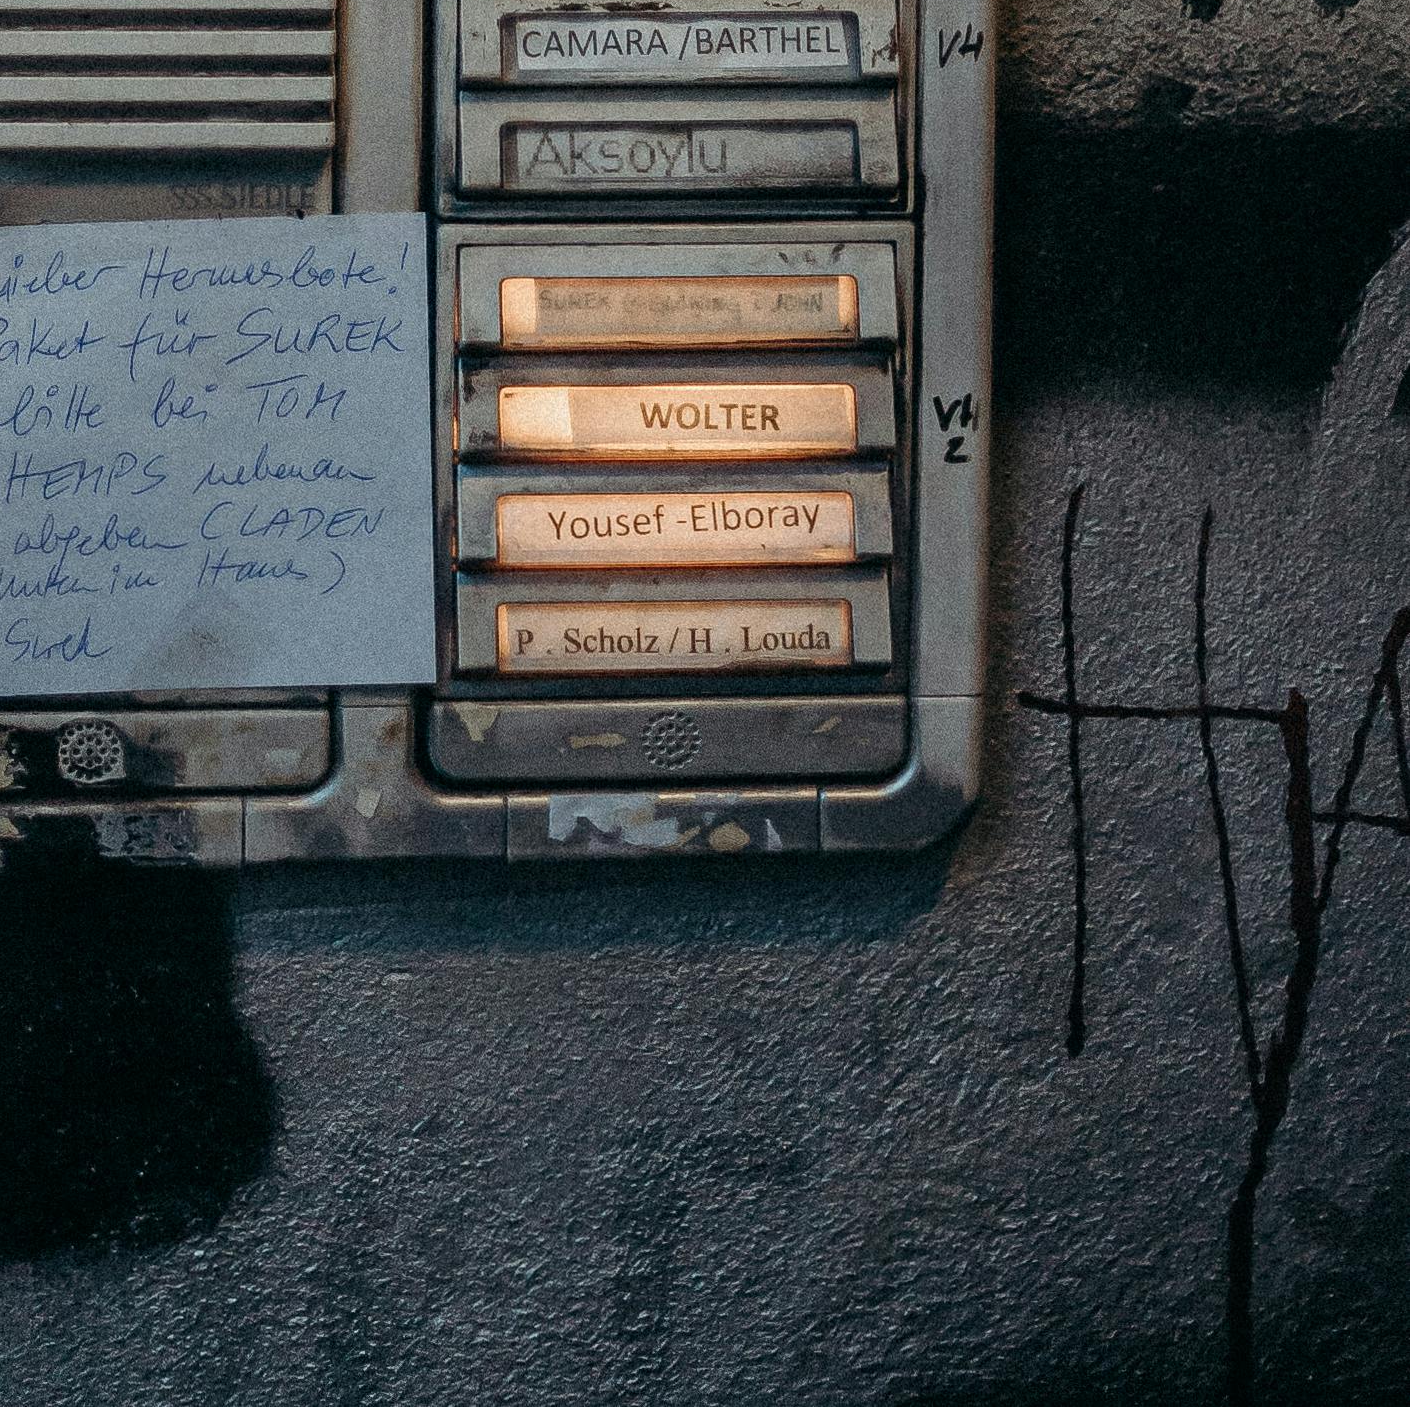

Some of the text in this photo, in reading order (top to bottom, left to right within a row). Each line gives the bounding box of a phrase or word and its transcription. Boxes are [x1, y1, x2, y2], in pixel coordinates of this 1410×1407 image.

[522, 29, 668, 59] CAMARA
[118, 308, 217, 382] für
[226, 307, 406, 366] SUREK
[152, 378, 216, 427] bei
[246, 374, 347, 424] TOM
[639, 402, 780, 432] WOLTER
[2, 443, 376, 504] HEMPS nebenan
[14, 513, 190, 568] abgeben
[547, 506, 663, 540] Yousef
[563, 626, 660, 654] Scholz
[742, 625, 831, 654] Louda
